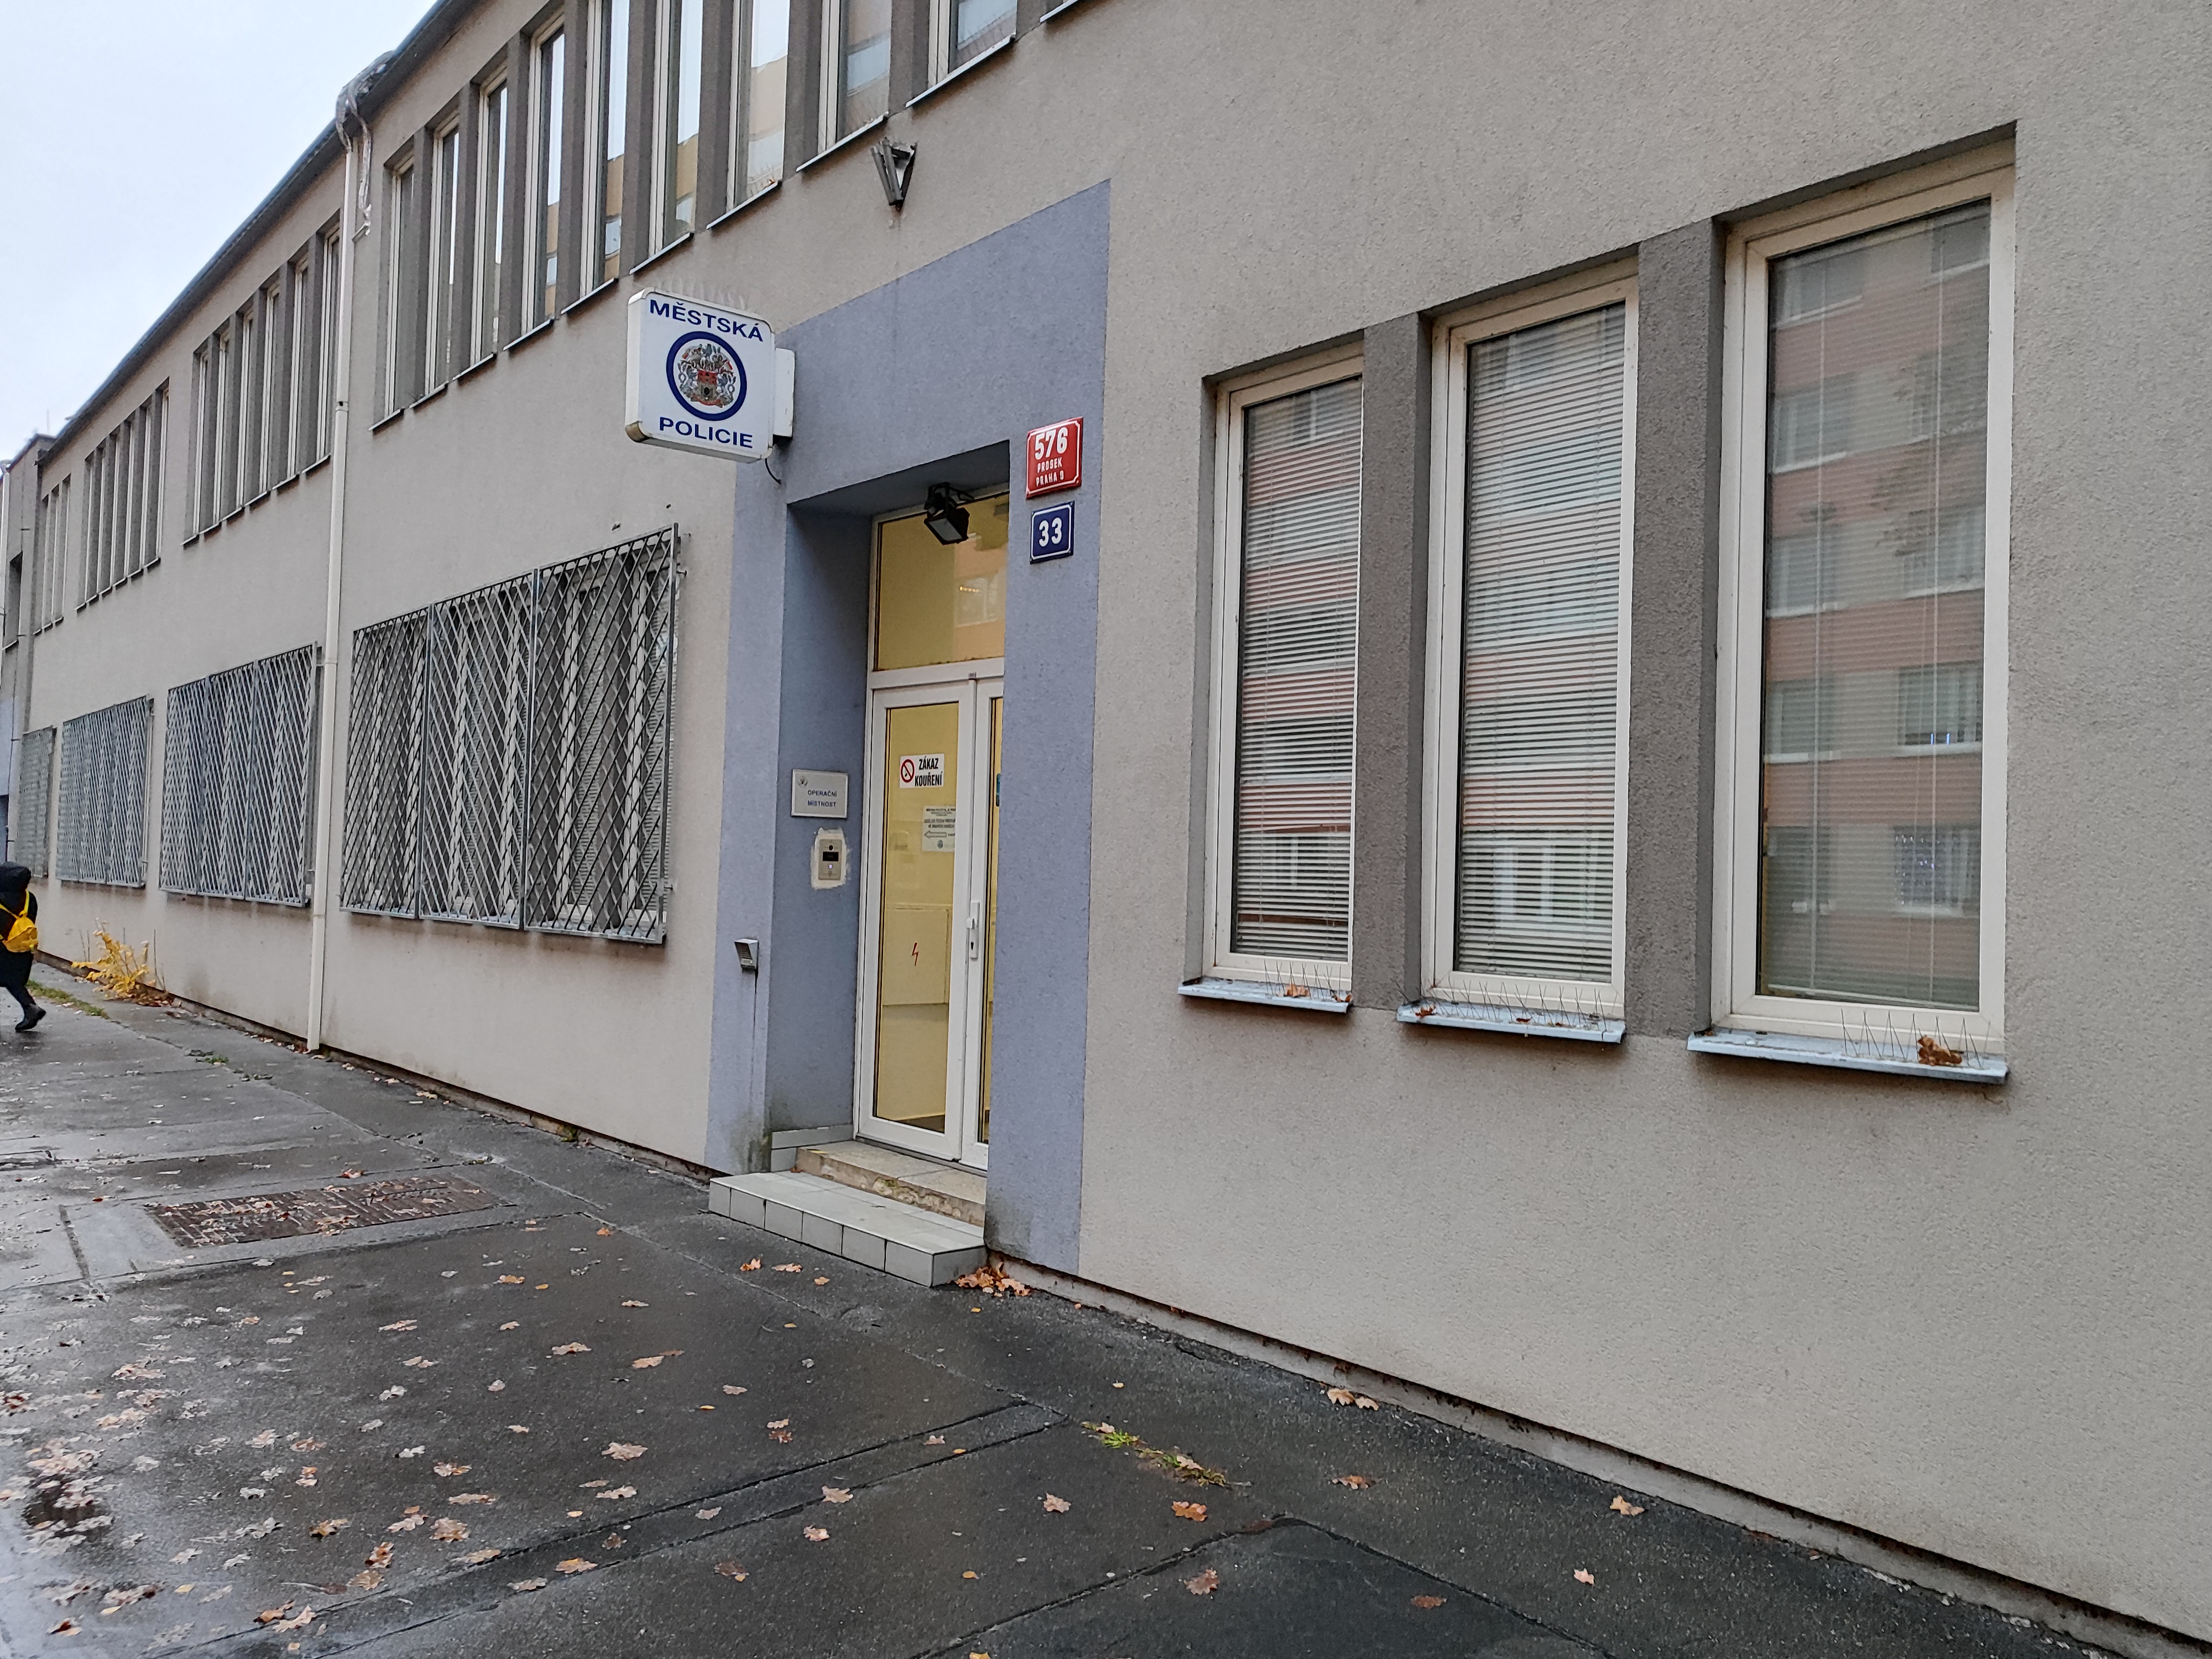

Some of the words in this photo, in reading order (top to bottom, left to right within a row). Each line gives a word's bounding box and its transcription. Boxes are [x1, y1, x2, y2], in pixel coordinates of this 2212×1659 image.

[649, 299, 764, 342] MĚSTSKÁ
[659, 416, 753, 448] POLICIE
[1034, 427, 1068, 460] 576
[1037, 456, 1062, 473] PROSEK
[1036, 472, 1057, 487] PRAHA
[1059, 470, 1065, 481] 9
[1039, 517, 1062, 547] 33
[919, 755, 939, 770] ZÁKAZ
[915, 771, 943, 787] KOUŘENÍ
